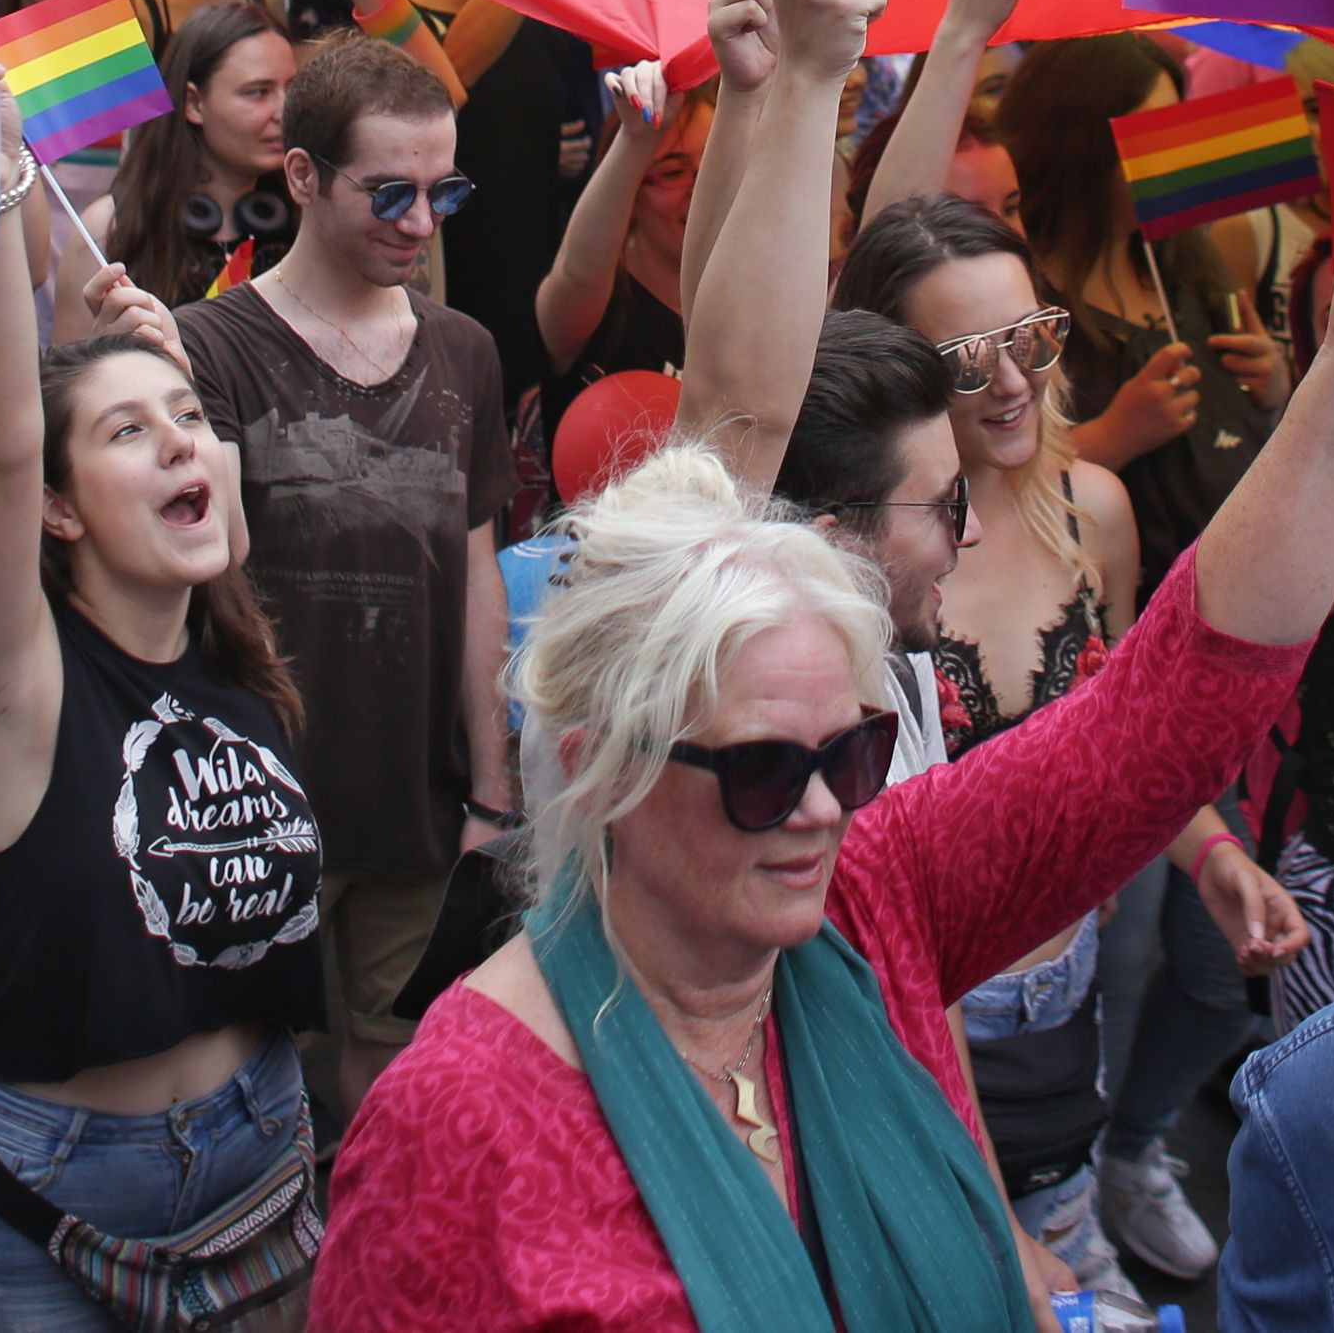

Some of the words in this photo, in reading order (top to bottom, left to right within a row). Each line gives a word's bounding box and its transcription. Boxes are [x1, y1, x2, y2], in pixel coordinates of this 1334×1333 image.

[167, 786, 289, 831] dreams
[209, 854, 272, 886] can
[175, 882, 216, 925] be
[228, 872, 294, 922] real
